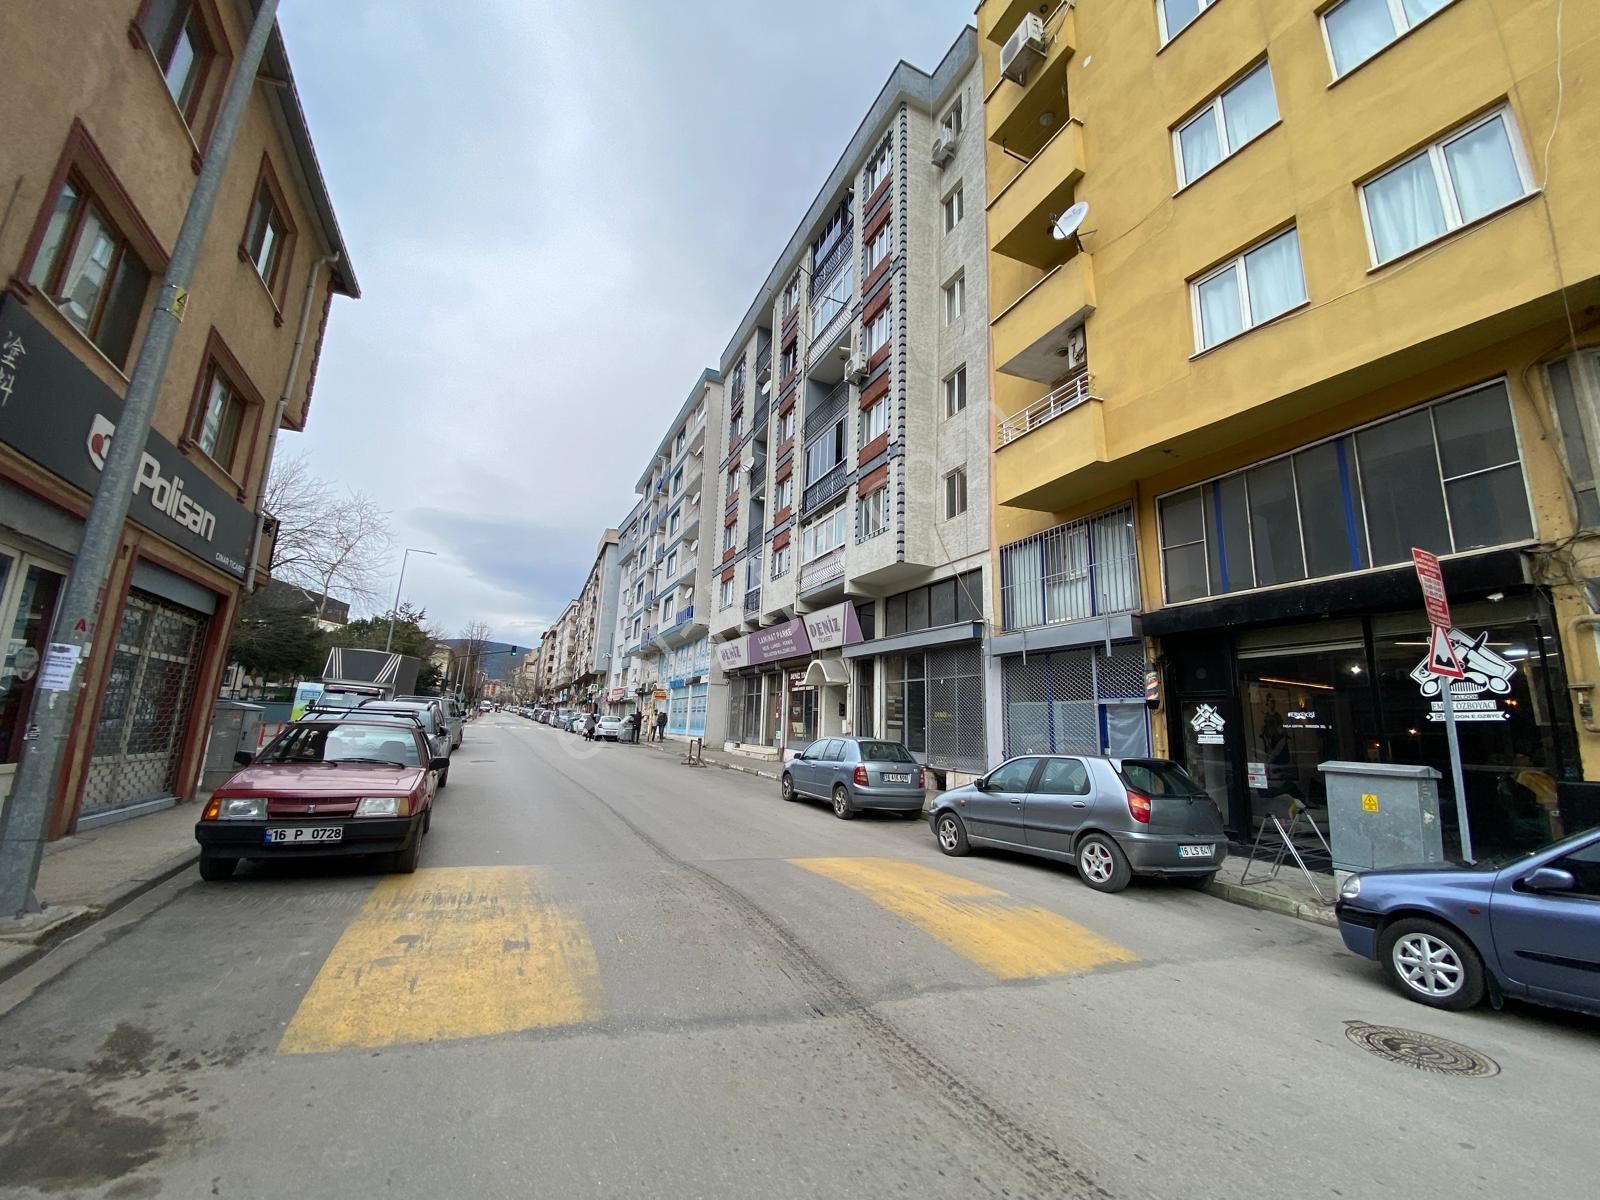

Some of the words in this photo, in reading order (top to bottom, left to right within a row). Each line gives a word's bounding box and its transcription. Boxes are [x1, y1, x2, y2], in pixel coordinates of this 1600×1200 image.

[132, 451, 216, 542] Polisan
[273, 829, 287, 841] 16
[294, 829, 304, 840] P
[311, 828, 342, 839] 0728
